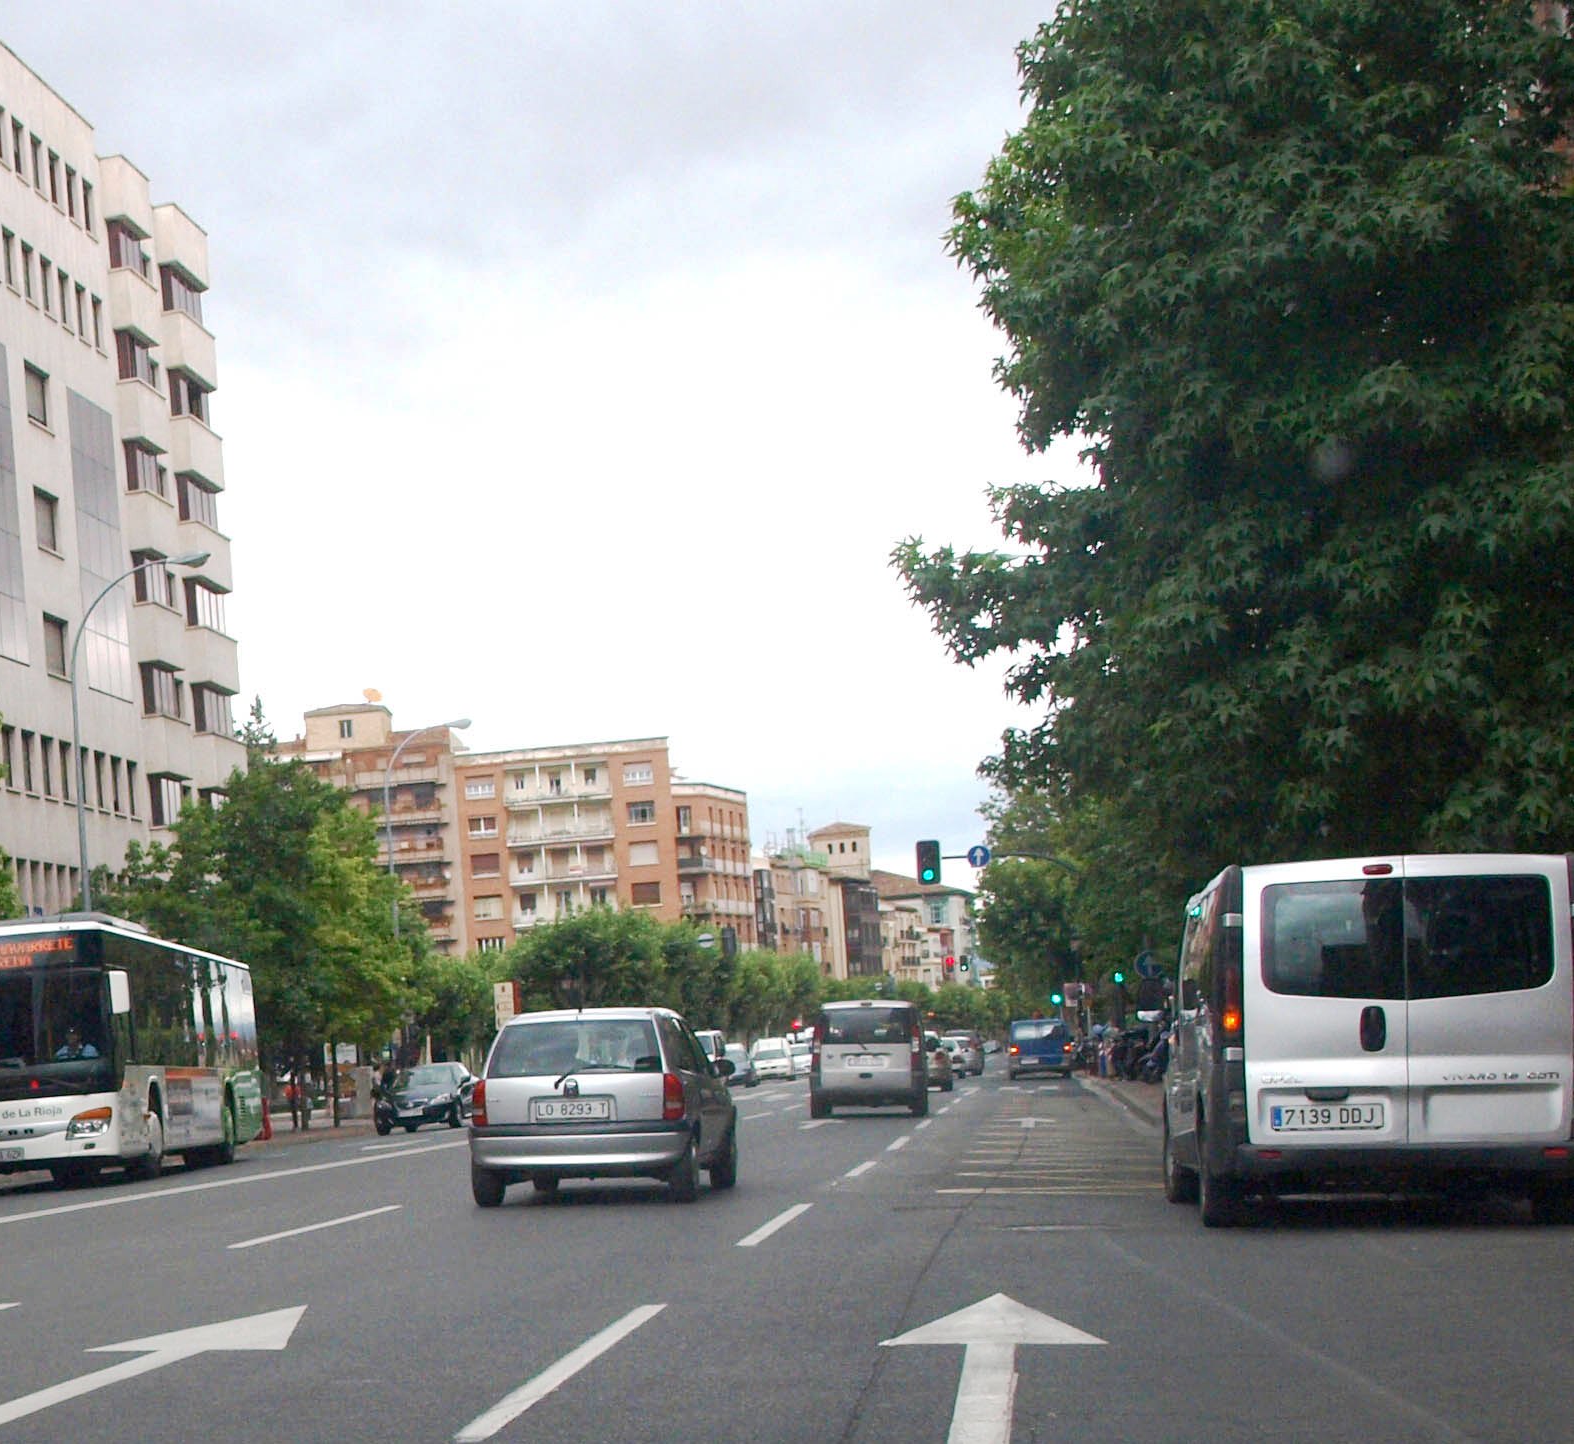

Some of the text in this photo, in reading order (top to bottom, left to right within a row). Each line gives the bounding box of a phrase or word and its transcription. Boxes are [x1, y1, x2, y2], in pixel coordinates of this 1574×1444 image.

[1, 1109, 16, 1120] de
[18, 1107, 32, 1118] La
[34, 1106, 64, 1117] Rioja
[561, 1103, 592, 1116] 8293
[1284, 1107, 1375, 1126] 7139 DDJ
